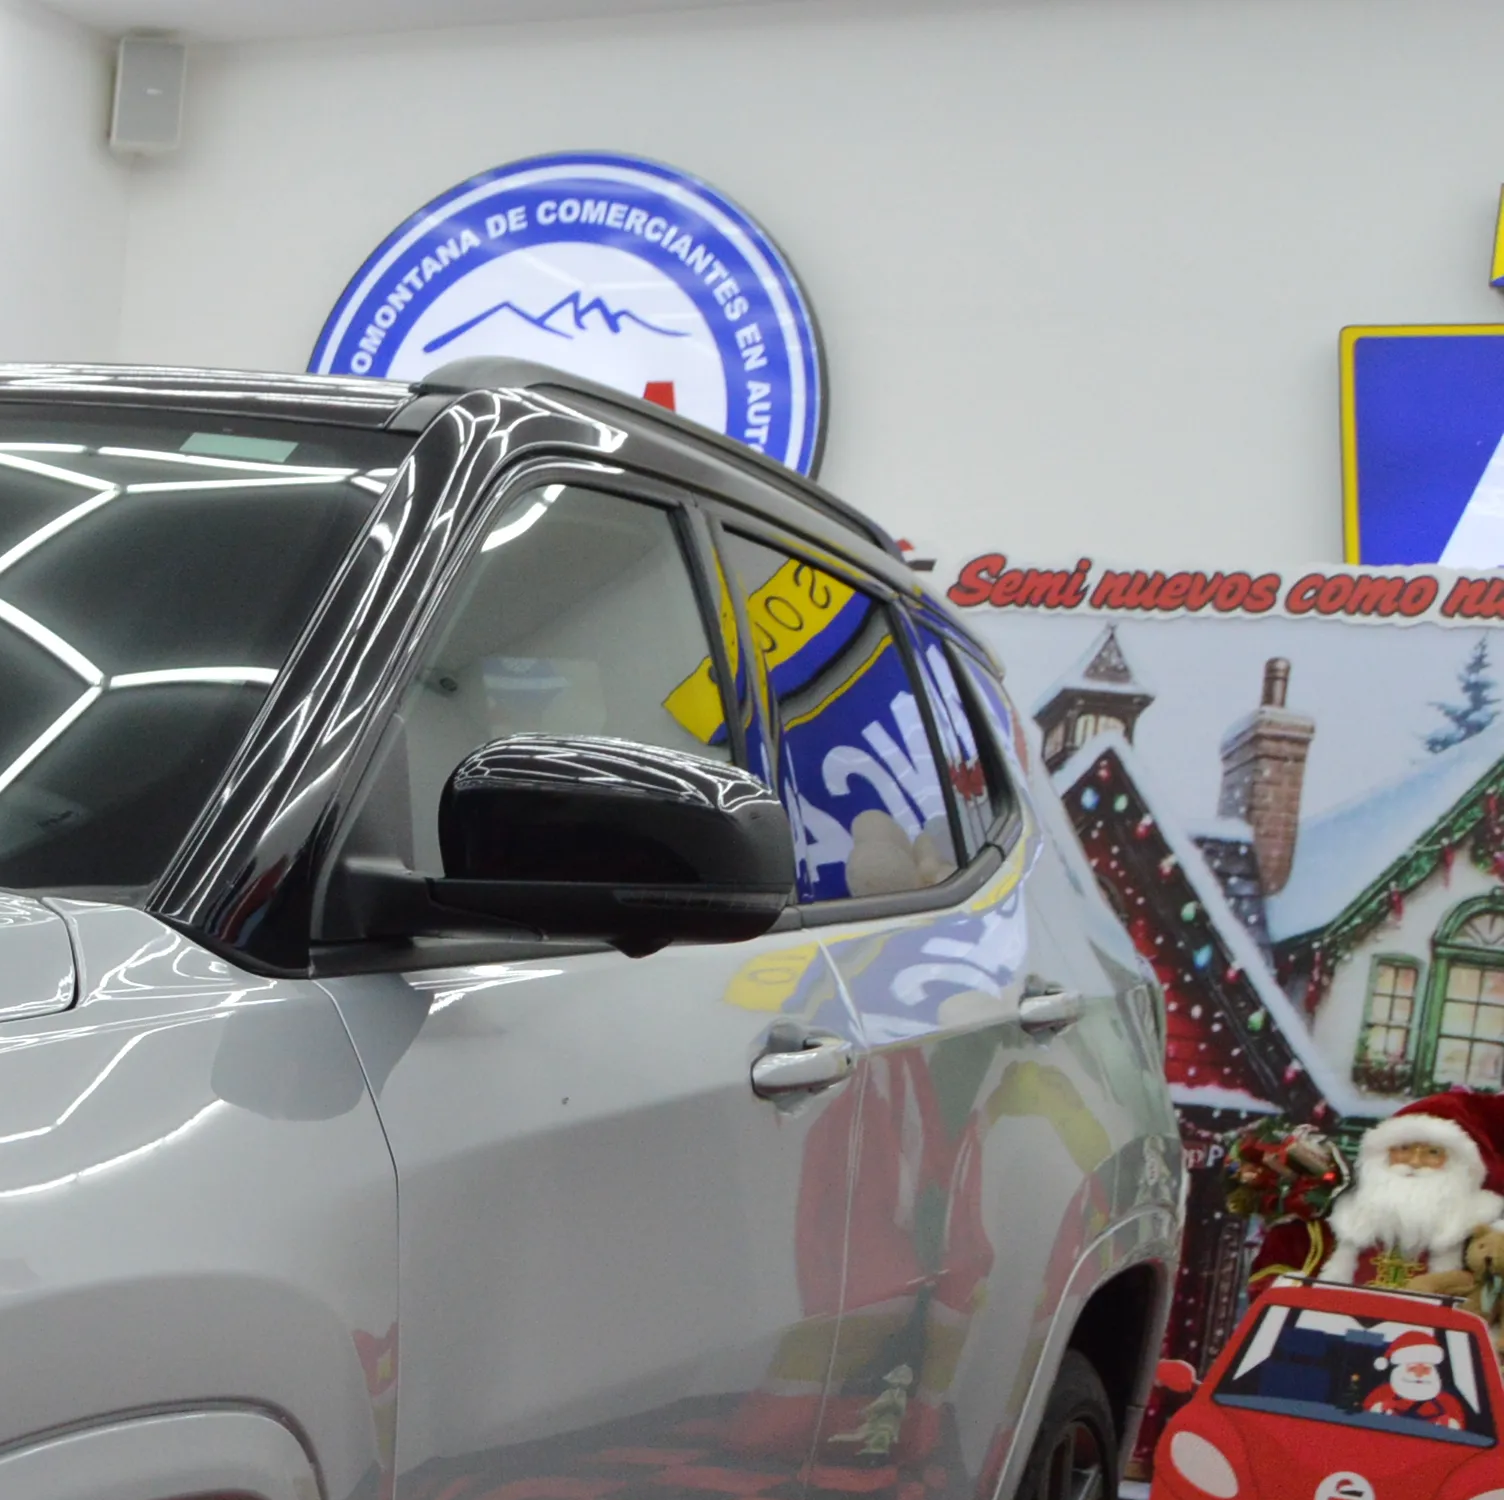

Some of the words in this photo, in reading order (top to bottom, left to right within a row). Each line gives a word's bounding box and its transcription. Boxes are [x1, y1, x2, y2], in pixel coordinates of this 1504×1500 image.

[485, 206, 528, 240] DE
[536, 198, 749, 321] COMERCIANTES
[735, 322, 768, 372] EN
[946, 552, 1092, 609] Semi
[1089, 569, 1282, 614] nuevos
[1284, 573, 1439, 617] como
